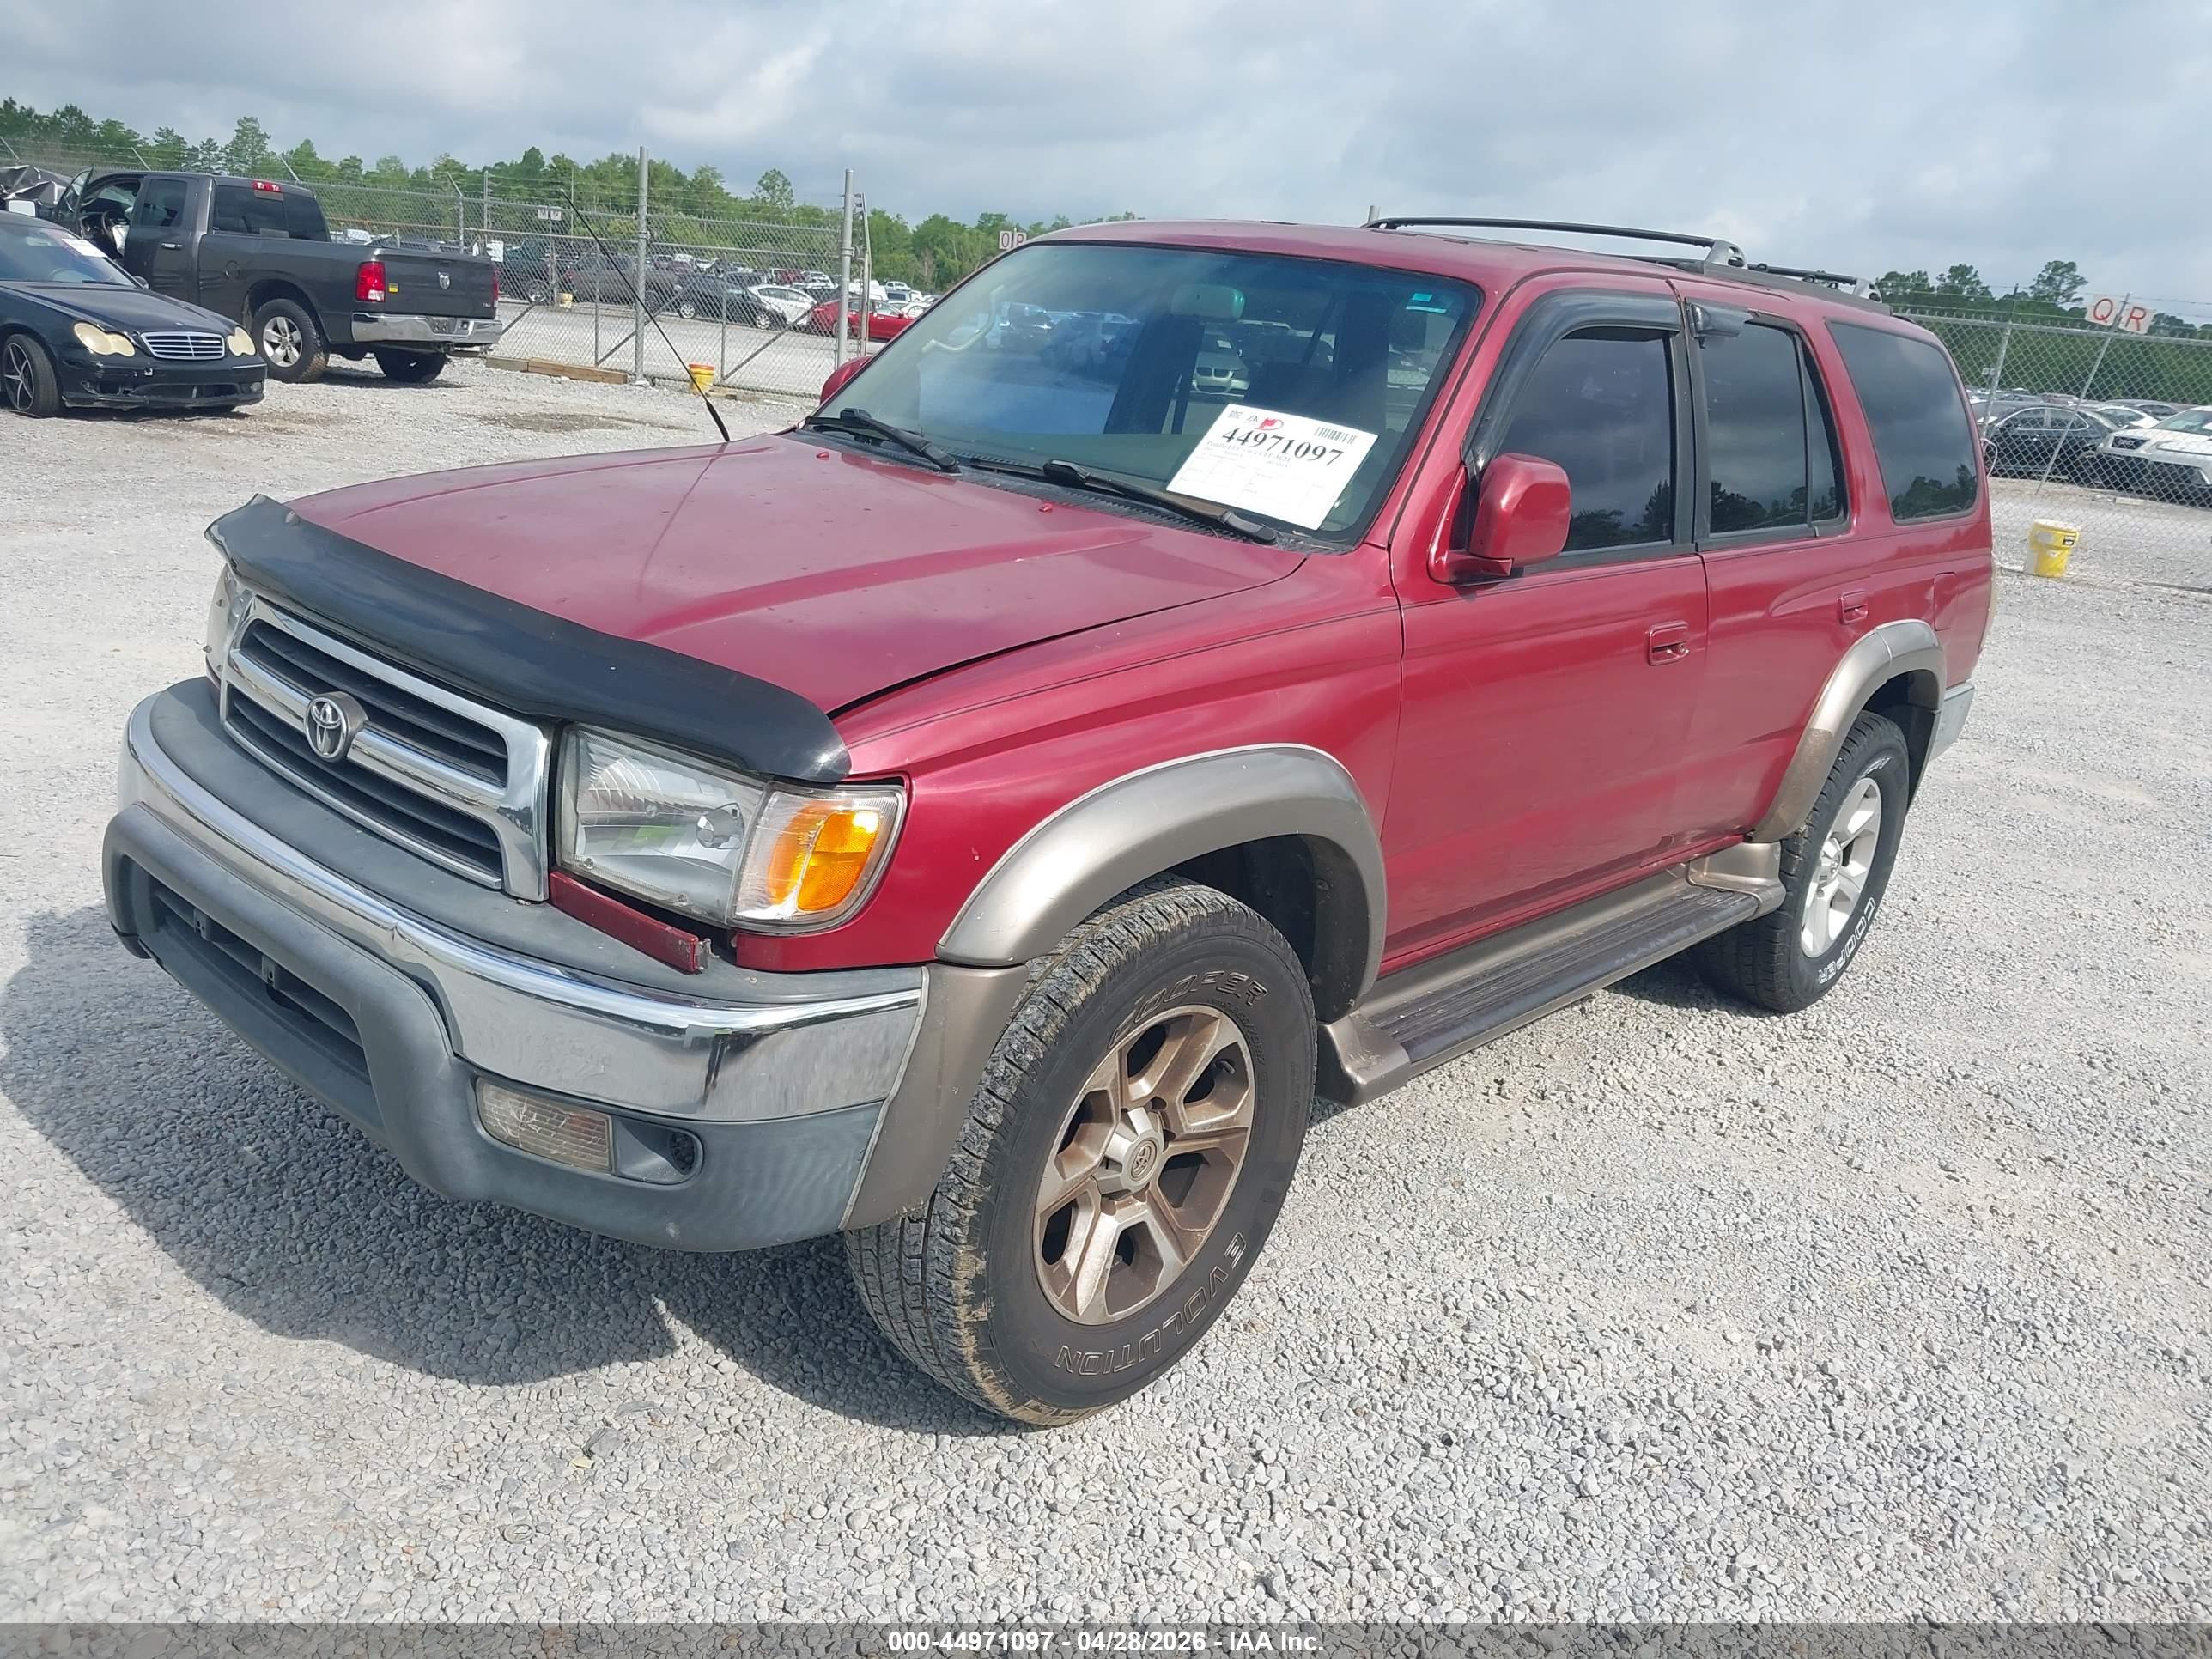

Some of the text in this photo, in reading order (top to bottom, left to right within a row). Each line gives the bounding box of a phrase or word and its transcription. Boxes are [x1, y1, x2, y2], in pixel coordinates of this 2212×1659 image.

[2093, 297, 2114, 324] Q
[2124, 305, 2148, 331] R
[1221, 428, 1345, 466] 44971097
[1817, 896, 1877, 985] COOPER
[1053, 1231, 1247, 1376] EVOLUTION
